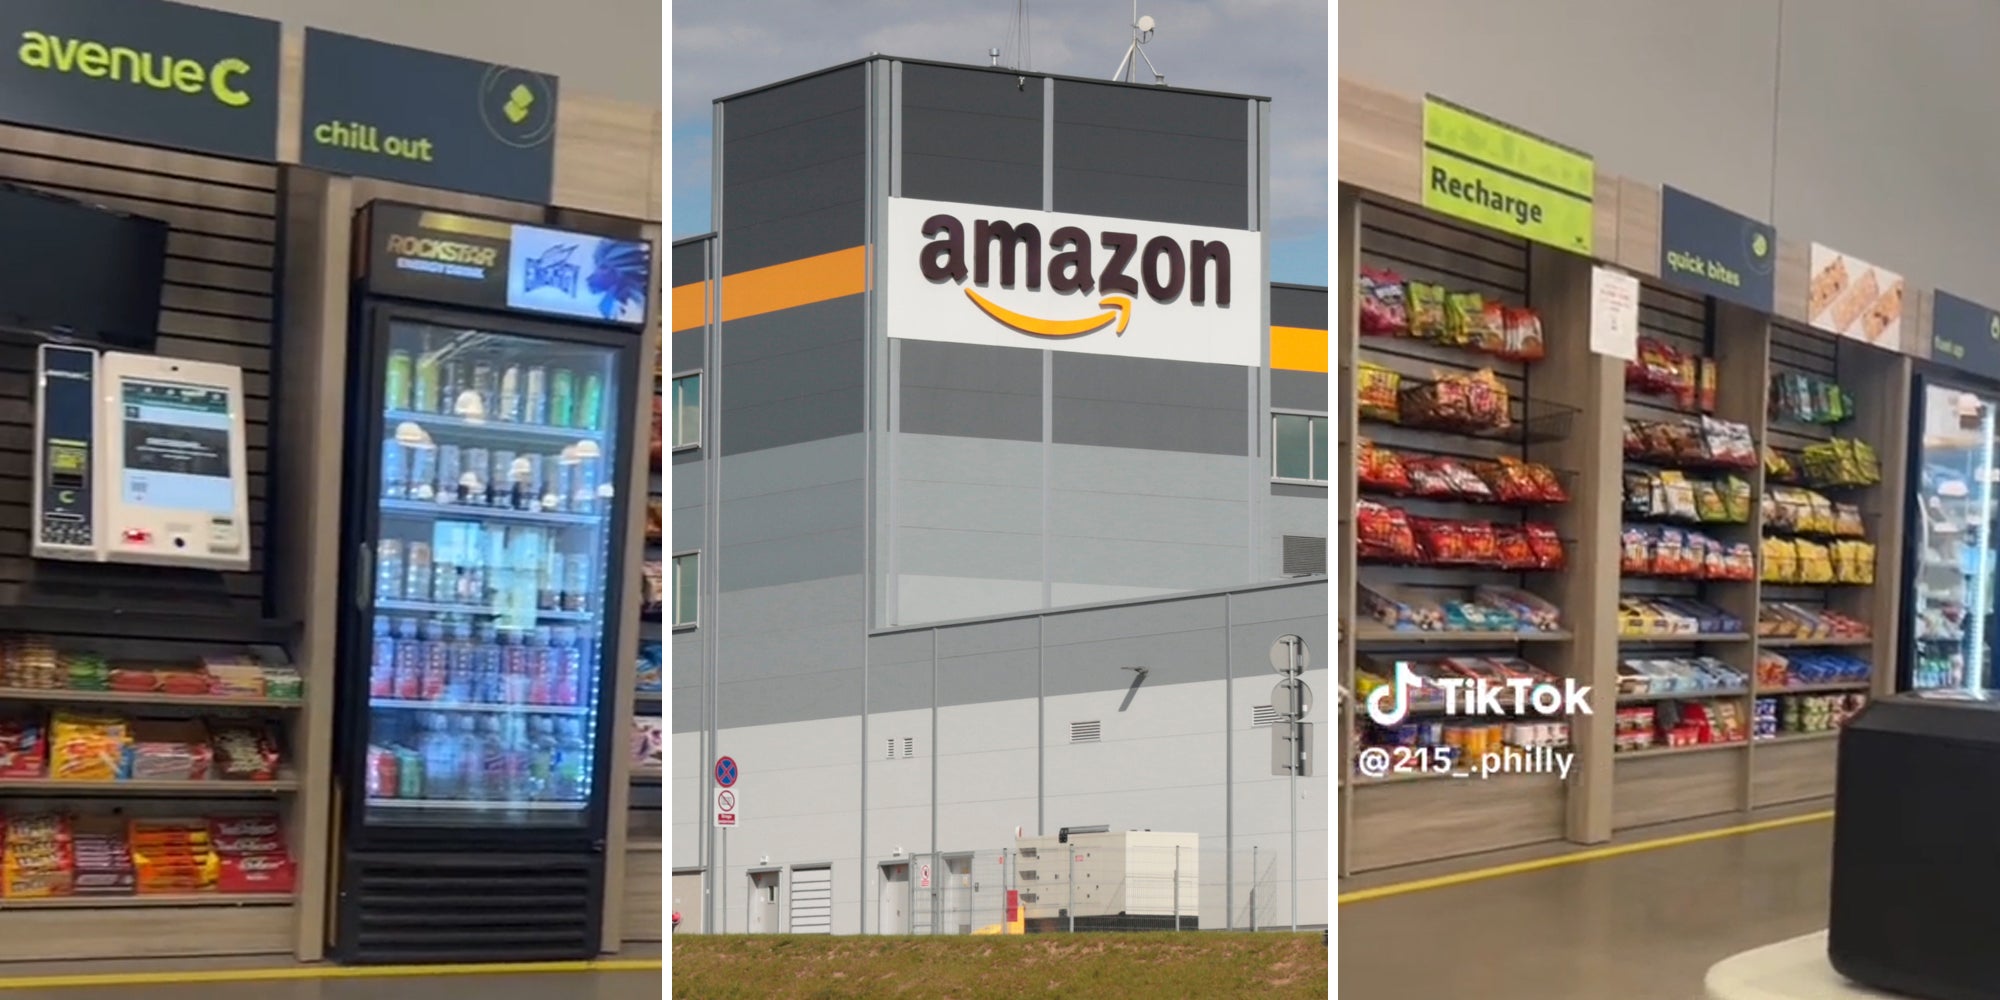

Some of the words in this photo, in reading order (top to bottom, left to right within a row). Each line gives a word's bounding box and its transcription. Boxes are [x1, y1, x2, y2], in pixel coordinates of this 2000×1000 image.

[314, 120, 379, 153] chill
[384, 135, 433, 162] out
[1431, 166, 1543, 225] Recharge
[386, 234, 498, 267] ROCKSTAR
[919, 213, 1231, 309] amazon
[1667, 251, 1705, 278] quick
[1708, 261, 1740, 287] bites
